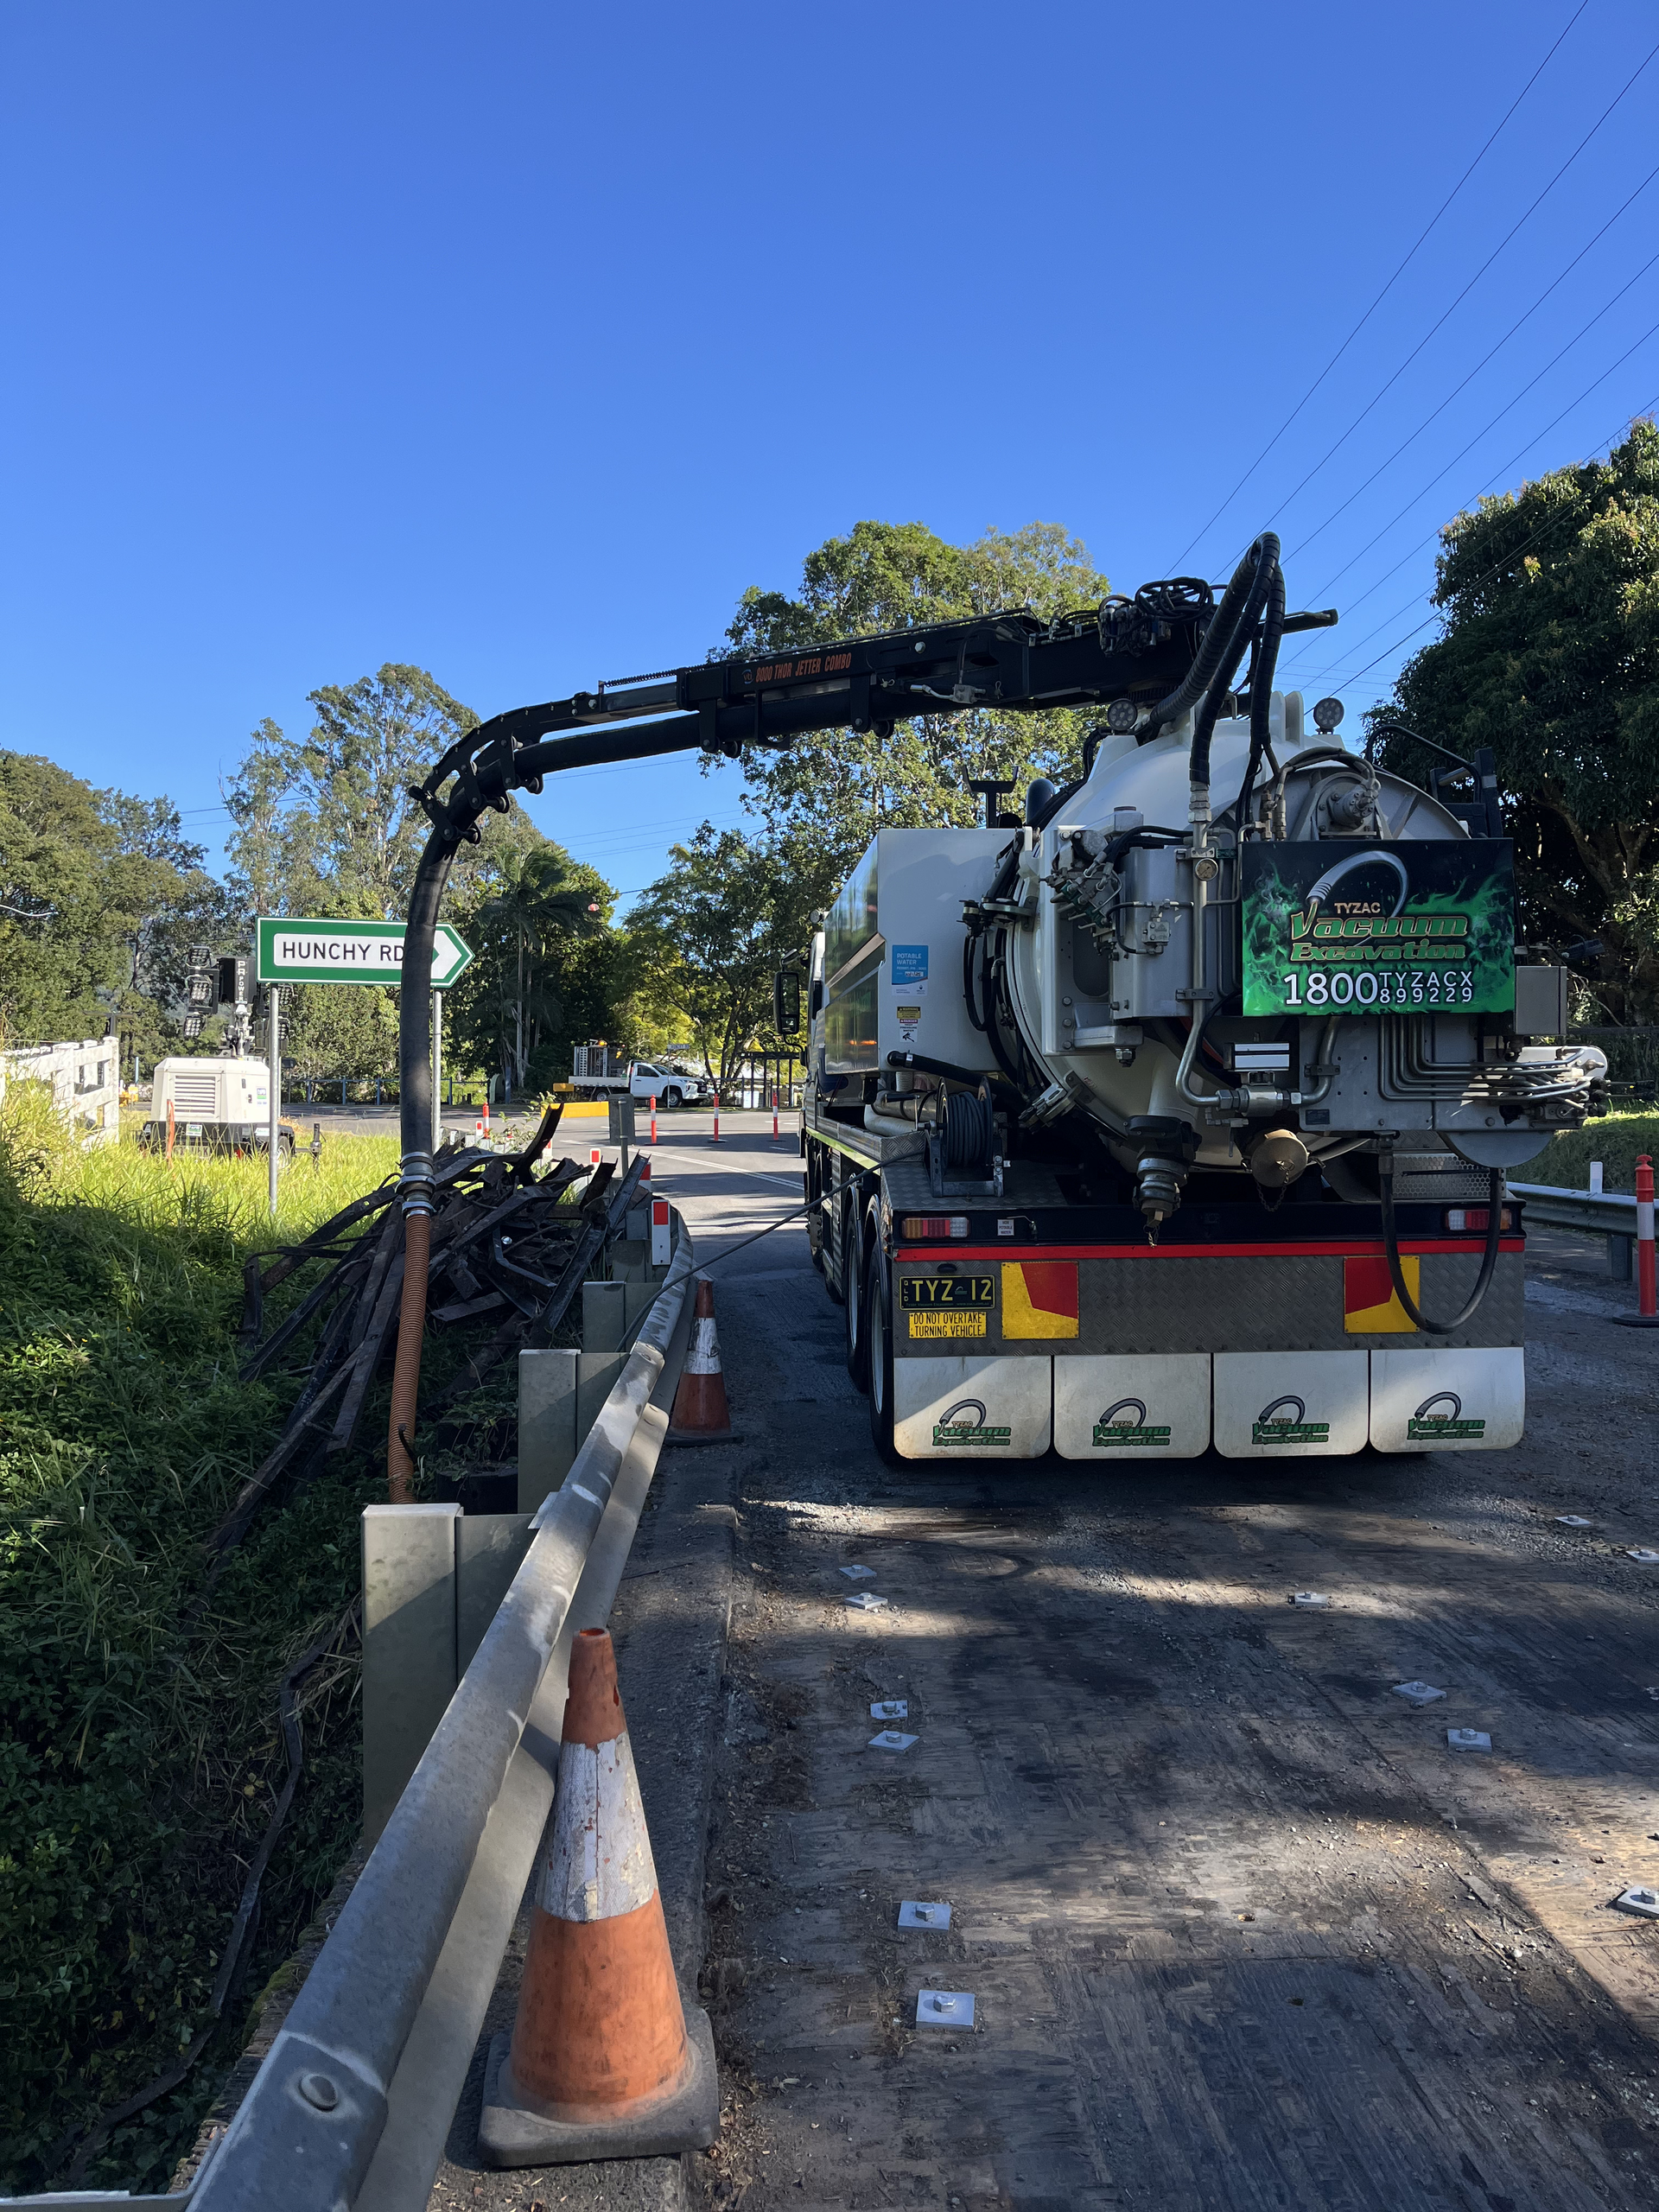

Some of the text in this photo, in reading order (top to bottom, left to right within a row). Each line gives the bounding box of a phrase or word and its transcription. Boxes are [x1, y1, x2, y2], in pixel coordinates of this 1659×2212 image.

[756, 665, 773, 683] 8000
[774, 662, 792, 680] THOR
[796, 658, 822, 677] JETTER
[824, 652, 852, 672] COMBO
[1334, 902, 1381, 914] TYZAC
[1290, 900, 1468, 940] Vacuum
[283, 941, 372, 961] HUNCHY
[1290, 938, 1466, 961] Excavation
[238, 960, 246, 976] PR
[1283, 972, 1378, 1005] 1800
[1379, 987, 1472, 1004] 899229
[912, 1280, 953, 1302] TYZ
[913, 1312, 982, 1325] DO NOT OVERTAKE
[915, 1325, 982, 1337] TURNING VEHICLE
